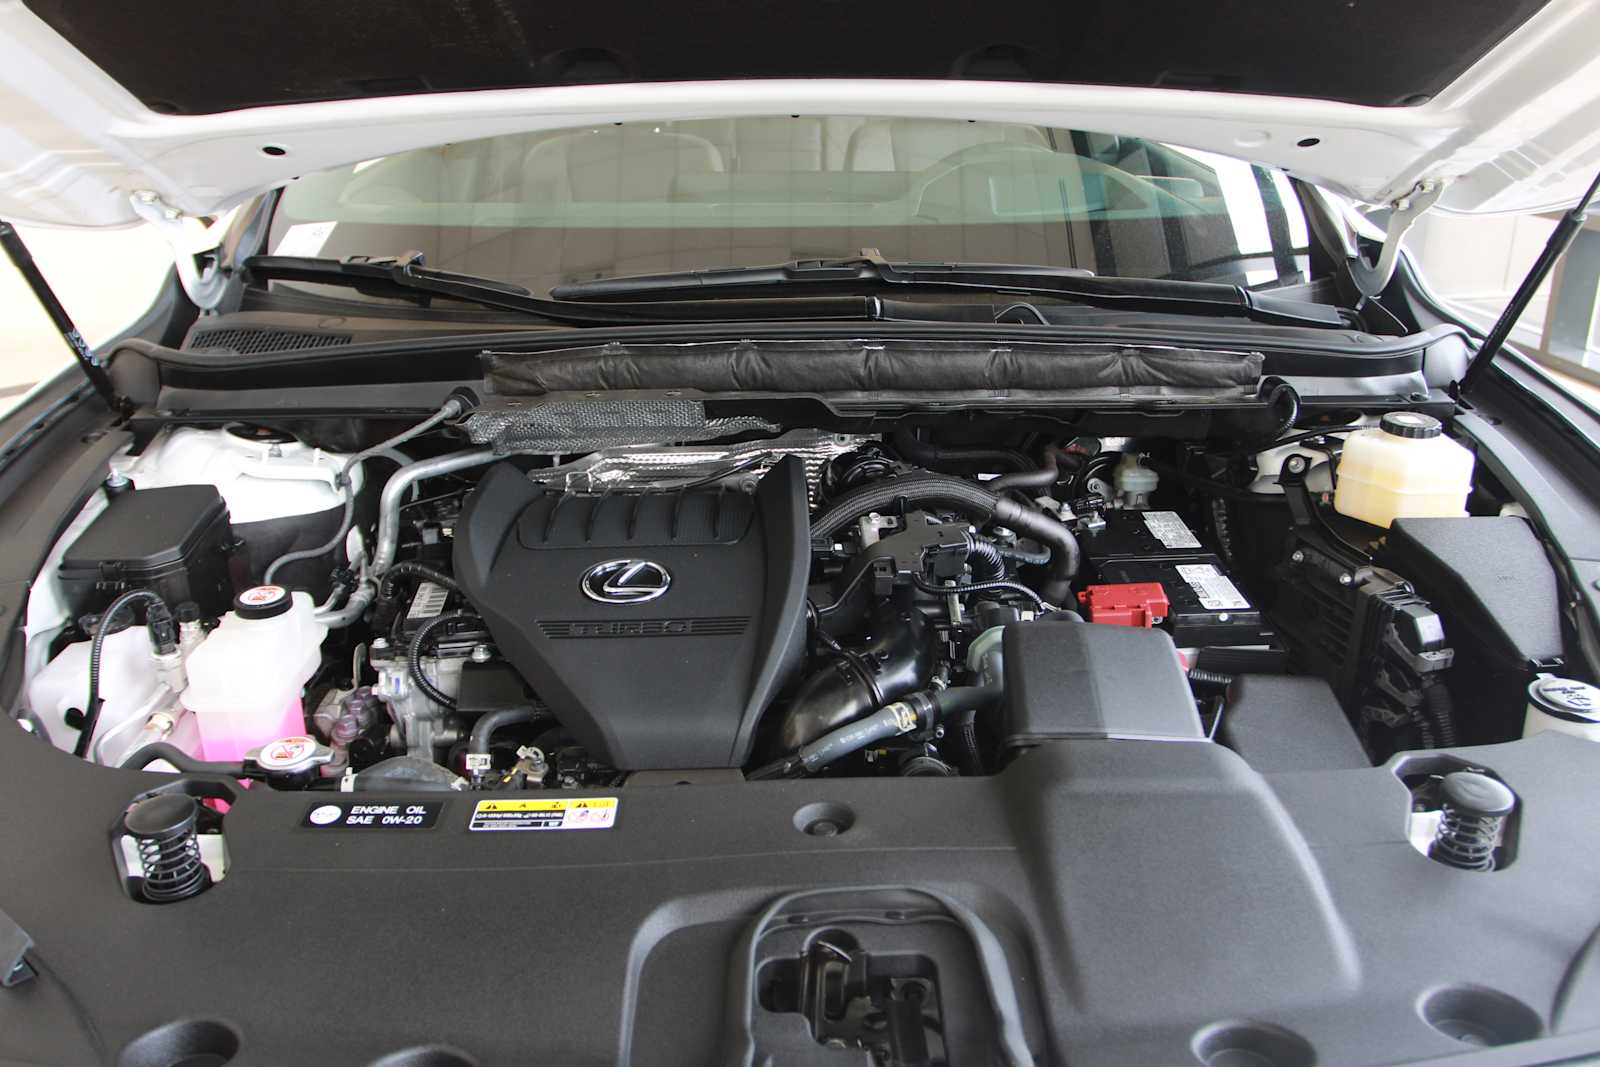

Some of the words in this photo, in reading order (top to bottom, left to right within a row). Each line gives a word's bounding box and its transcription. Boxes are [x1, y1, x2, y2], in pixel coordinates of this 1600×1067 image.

[350, 805, 399, 815] ENGINE
[406, 805, 427, 815] OIL
[346, 815, 375, 825] SAE
